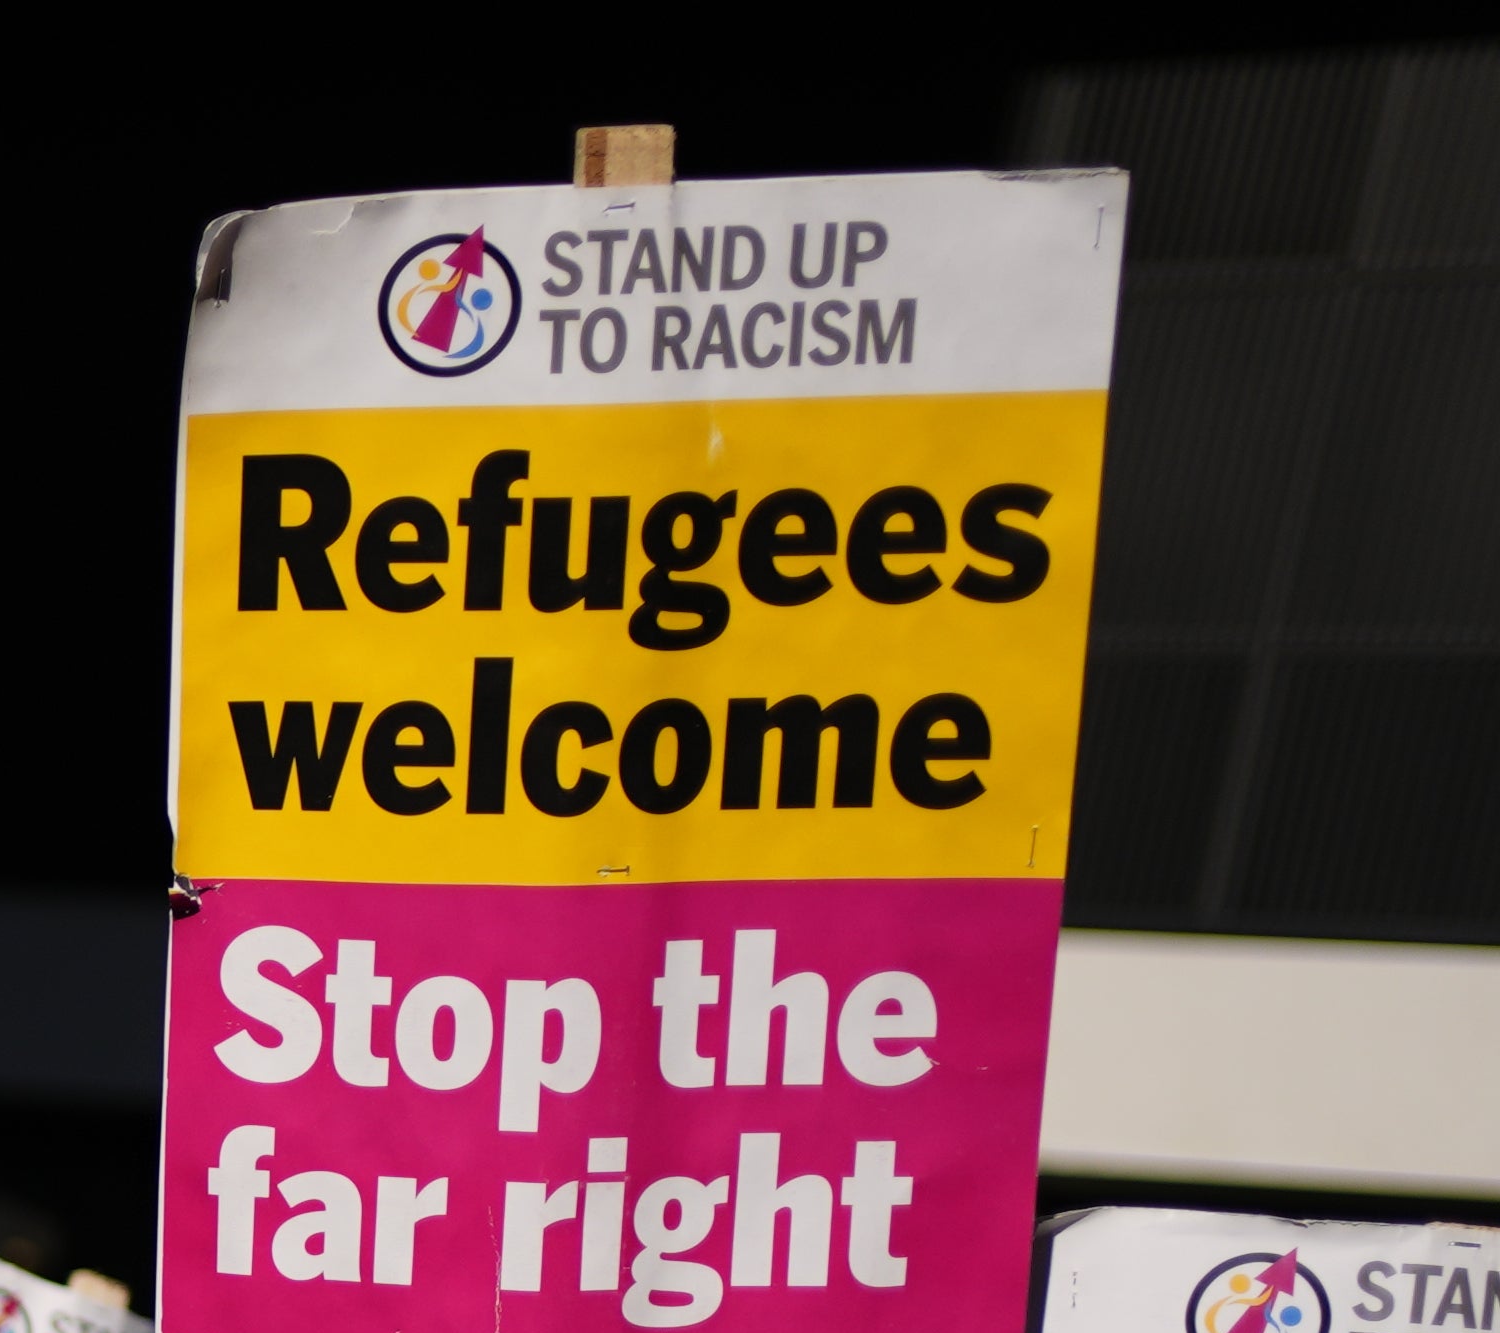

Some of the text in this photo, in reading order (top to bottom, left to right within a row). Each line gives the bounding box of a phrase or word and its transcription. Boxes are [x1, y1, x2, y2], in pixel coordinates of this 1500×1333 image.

[537, 297, 919, 377] TO RACISM
[540, 219, 890, 299] STAND UP
[236, 447, 1054, 653] Refugees
[227, 656, 993, 818] welcome
[212, 924, 940, 1133] Stop the
[206, 1124, 915, 1329] far right
